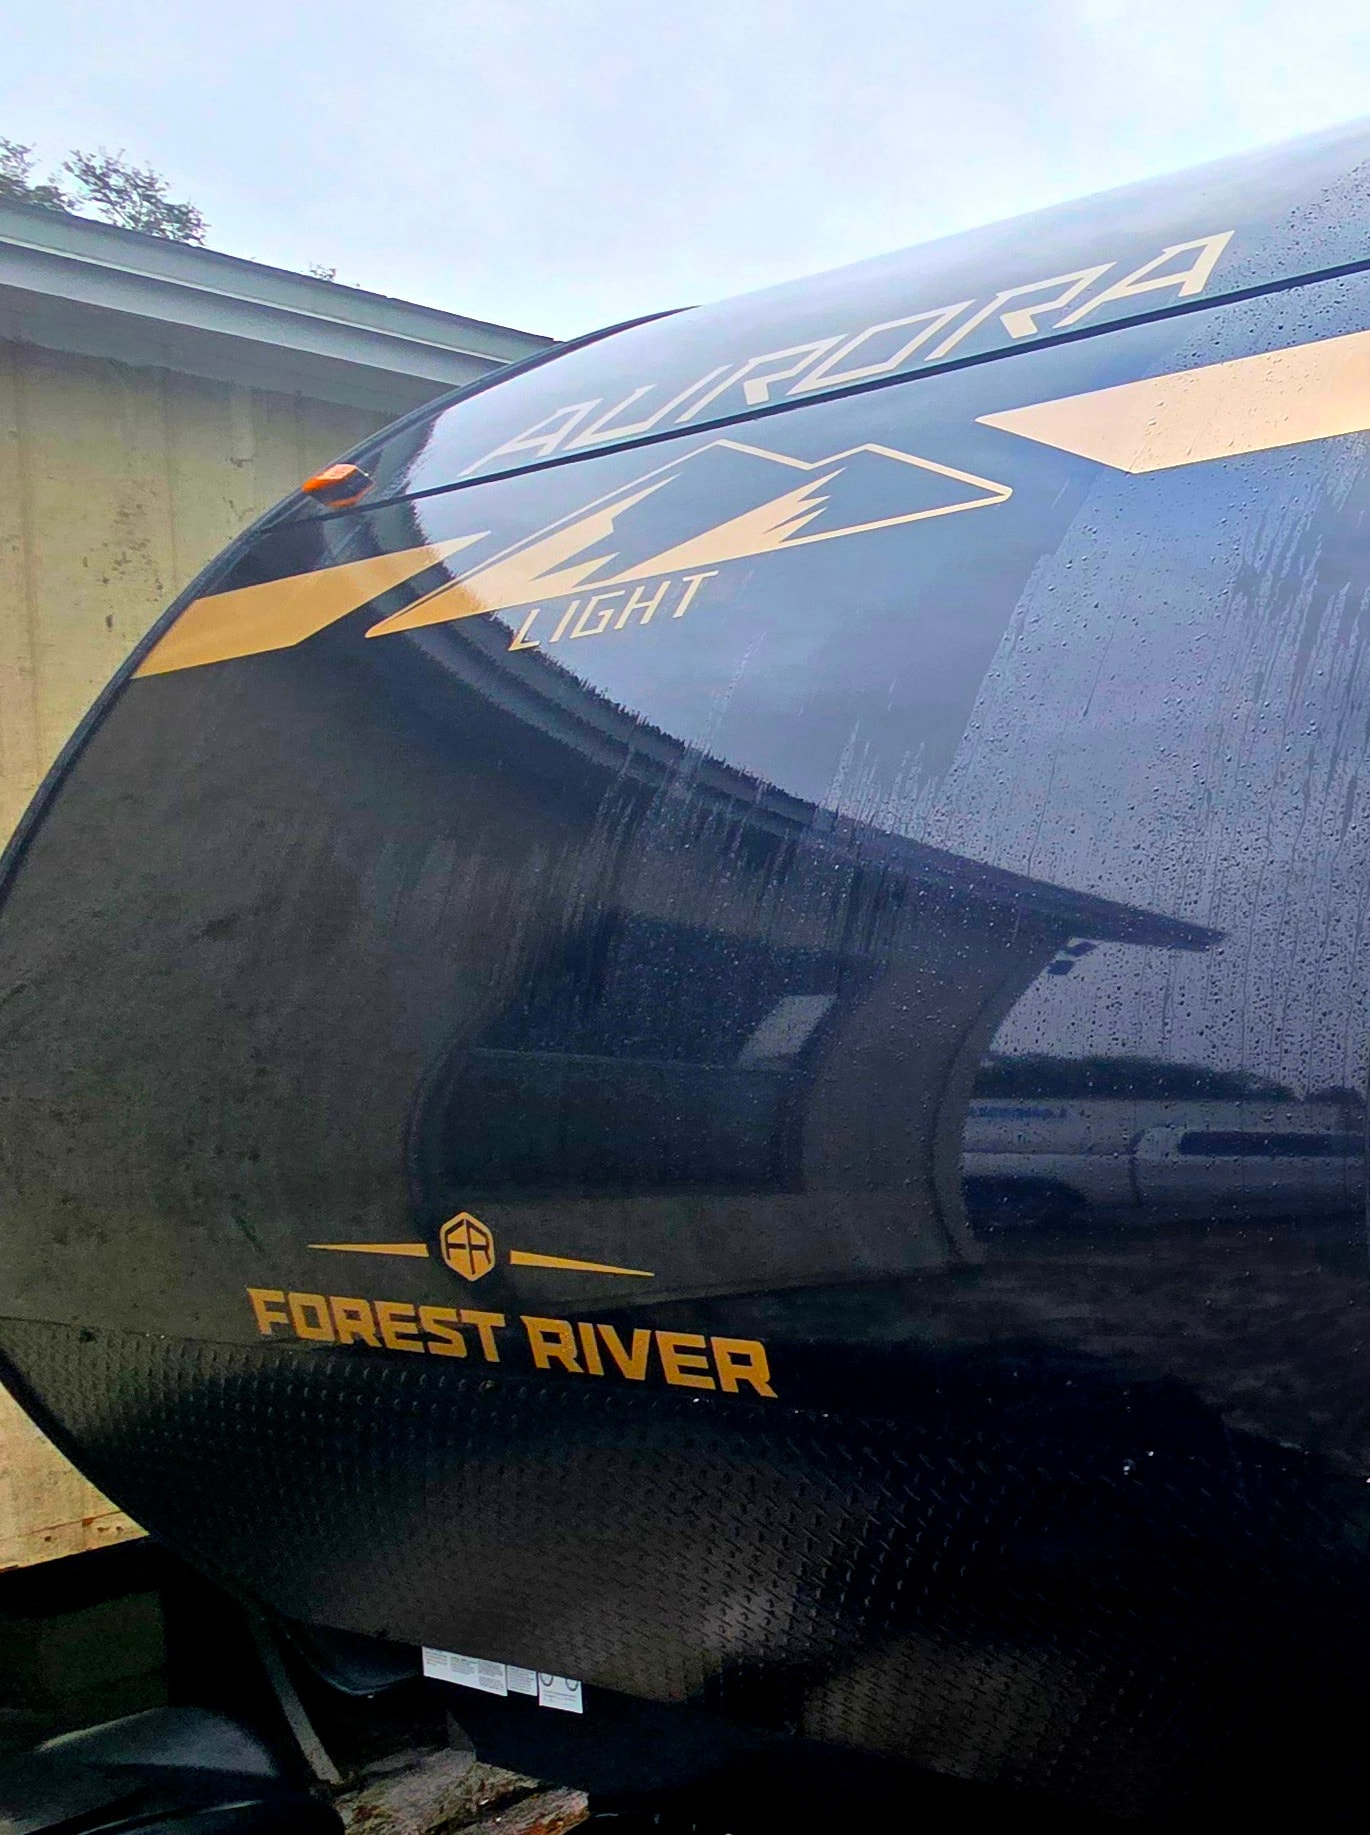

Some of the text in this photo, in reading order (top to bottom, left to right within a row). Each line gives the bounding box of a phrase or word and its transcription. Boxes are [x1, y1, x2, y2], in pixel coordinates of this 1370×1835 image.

[457, 229, 1236, 477] AURORA
[507, 570, 719, 652] LIGHT
[246, 1287, 779, 1399] FOREST RIVER
